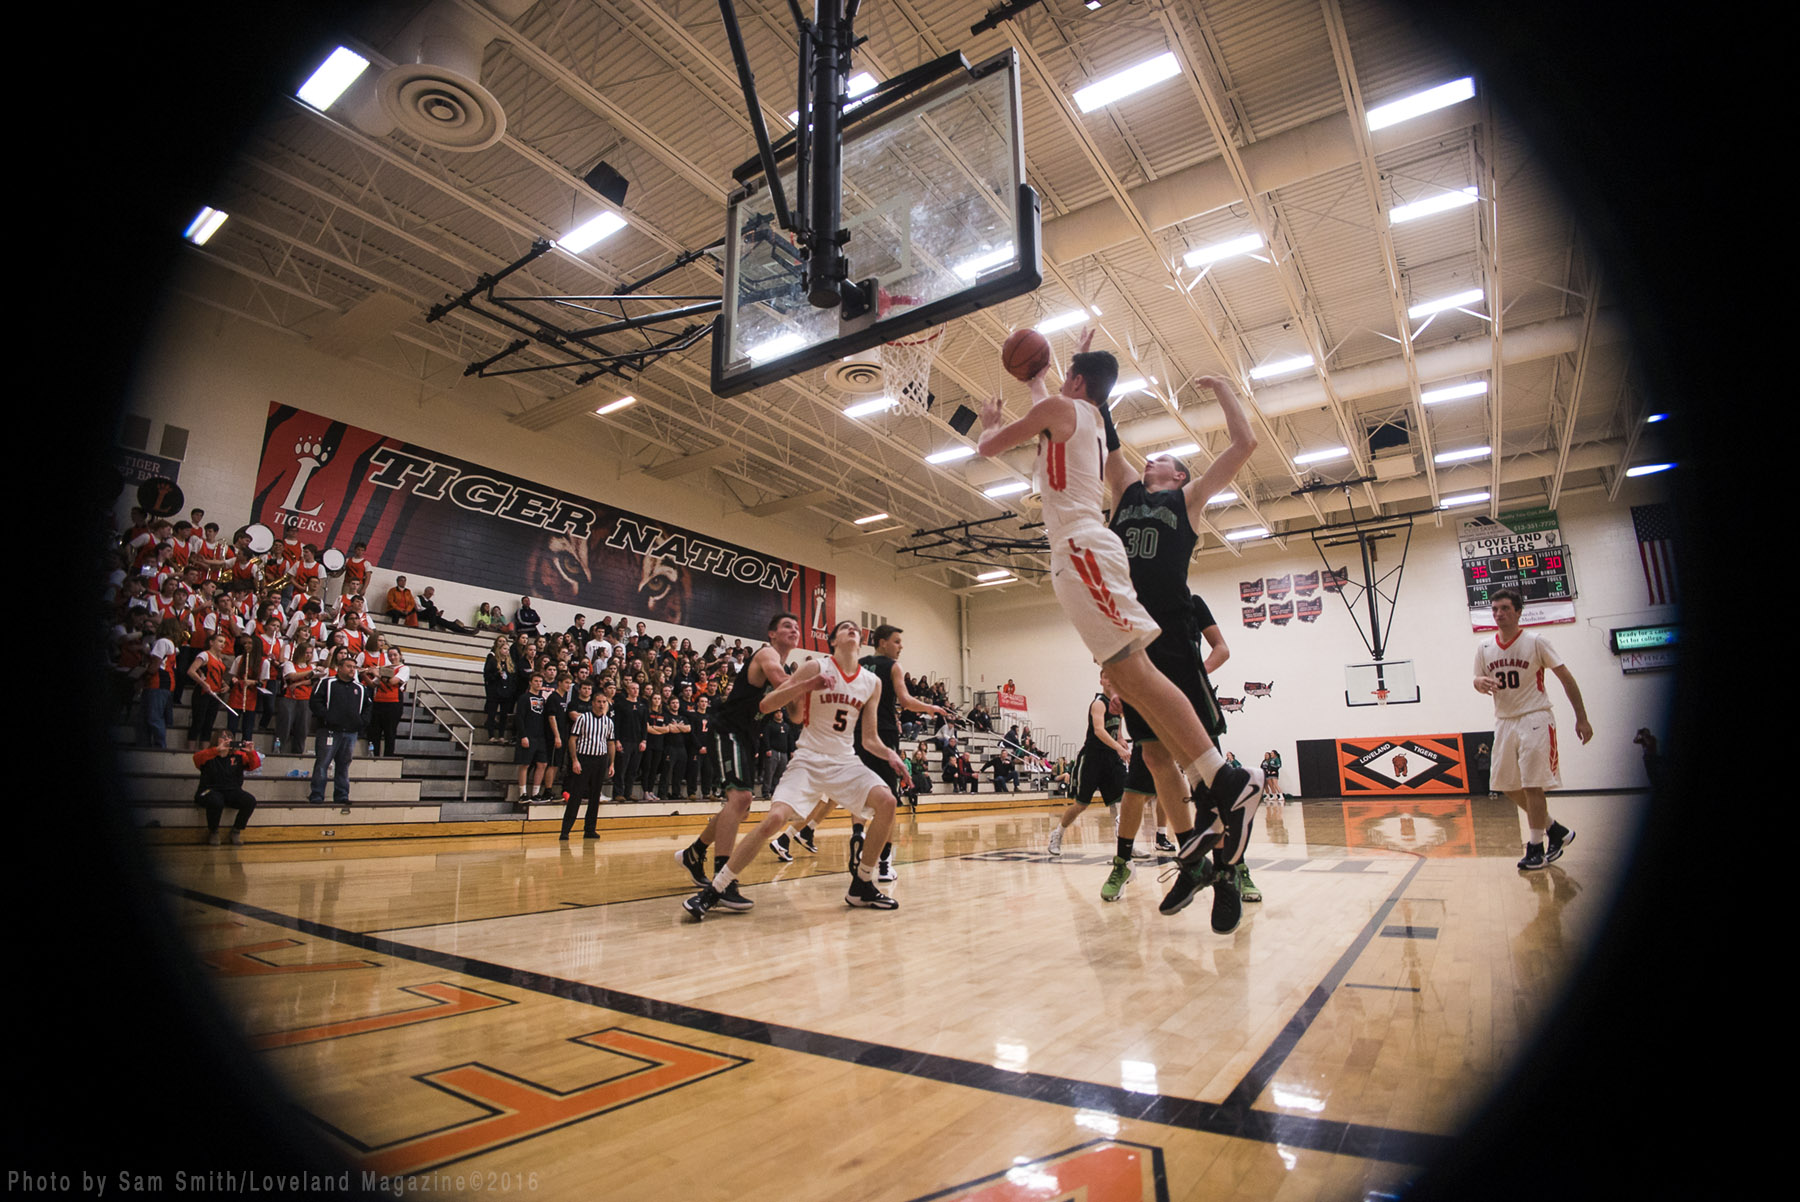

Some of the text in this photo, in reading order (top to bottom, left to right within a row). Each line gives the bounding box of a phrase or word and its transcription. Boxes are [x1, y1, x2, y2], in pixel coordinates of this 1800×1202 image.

[124, 456, 161, 473] TIGER
[280, 456, 325, 517] L
[273, 511, 326, 533] TIGERS
[369, 446, 798, 593] TIGER NATION
[1124, 527, 1159, 559] 30
[1477, 532, 1542, 549] LOVELAND
[1487, 542, 1535, 556] TIGERS
[1539, 549, 1562, 559] VISITOR
[1465, 560, 1487, 568] HOME
[1501, 554, 1535, 570] 7:06
[1544, 556, 1562, 570] 30
[1471, 566, 1488, 579] 35
[1519, 570, 1527, 579] 4
[1501, 580, 1519, 588] PLAYER
[1555, 581, 1562, 591] 2
[1480, 590, 1488, 600] 3
[812, 596, 828, 631] L
[810, 630, 829, 641] TIGERS
[1486, 658, 1530, 672] LOVELAND
[1495, 670, 1520, 690] 30
[833, 708, 848, 733] 5
[1359, 743, 1438, 764] LOVELAND TIGERS
